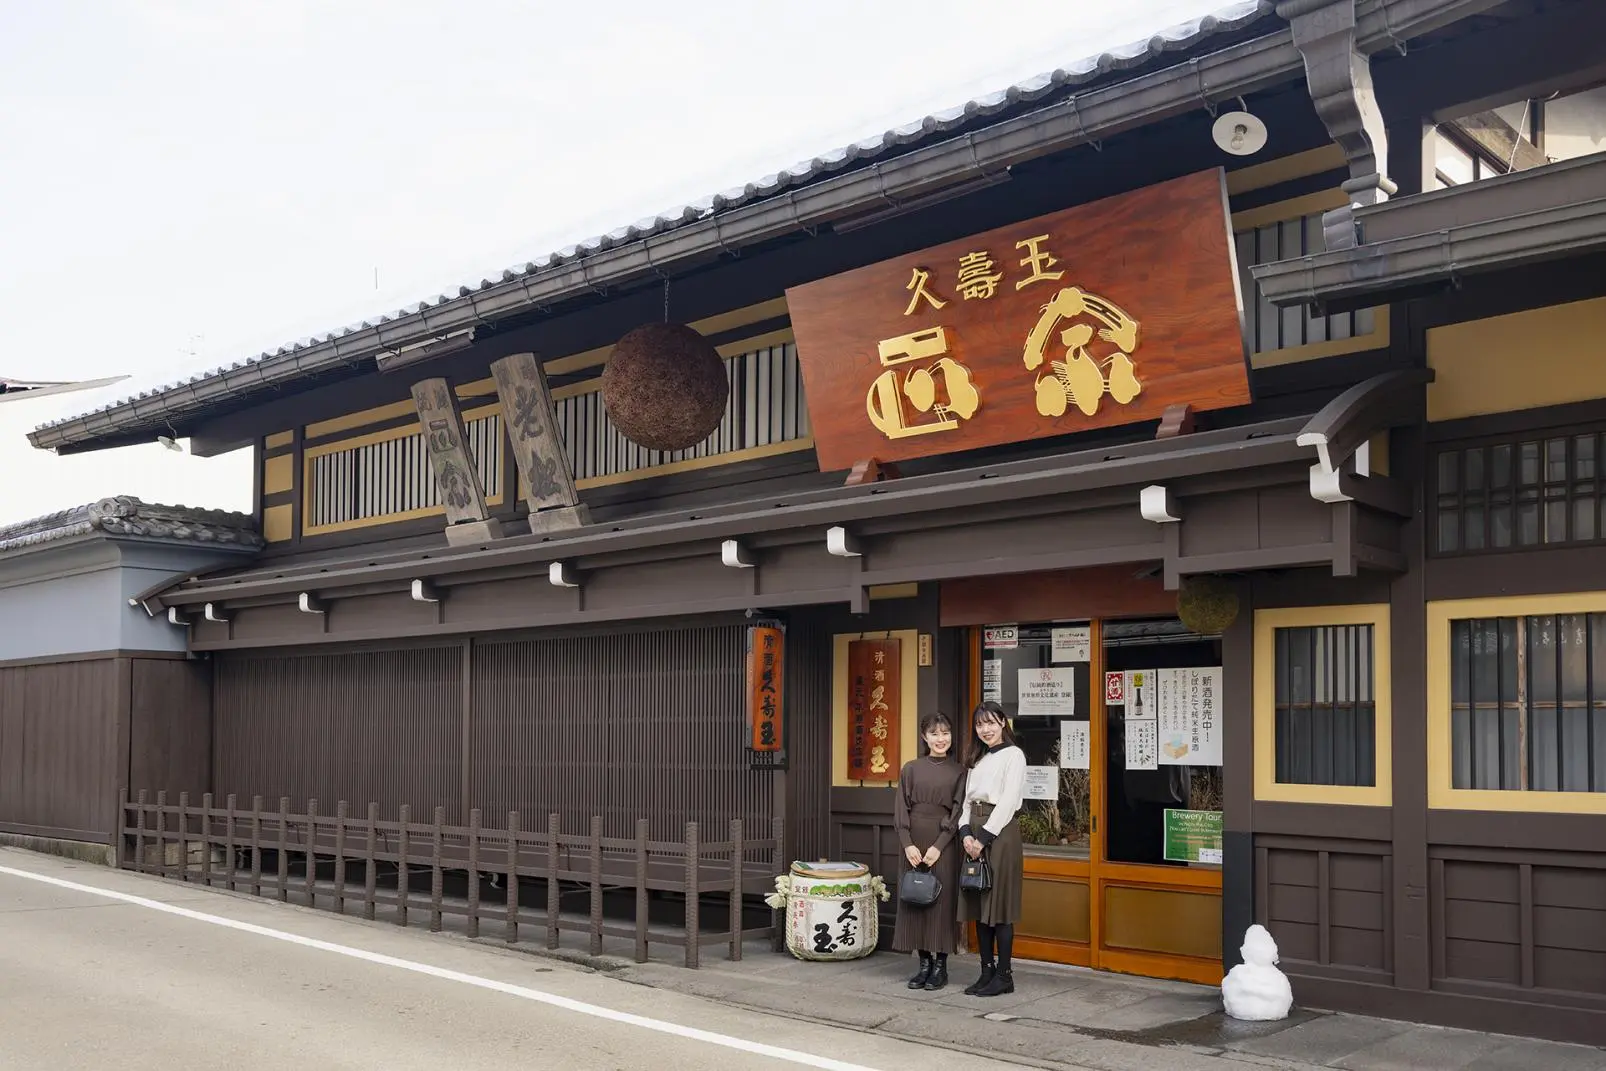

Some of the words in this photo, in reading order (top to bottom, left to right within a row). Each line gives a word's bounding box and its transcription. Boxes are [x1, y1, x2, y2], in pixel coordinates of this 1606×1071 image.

[903, 233, 1065, 316] 久壽玉
[994, 630, 1015, 640] AED
[1110, 680, 1119, 697] 甘酒
[1172, 811, 1203, 821] Brewery
